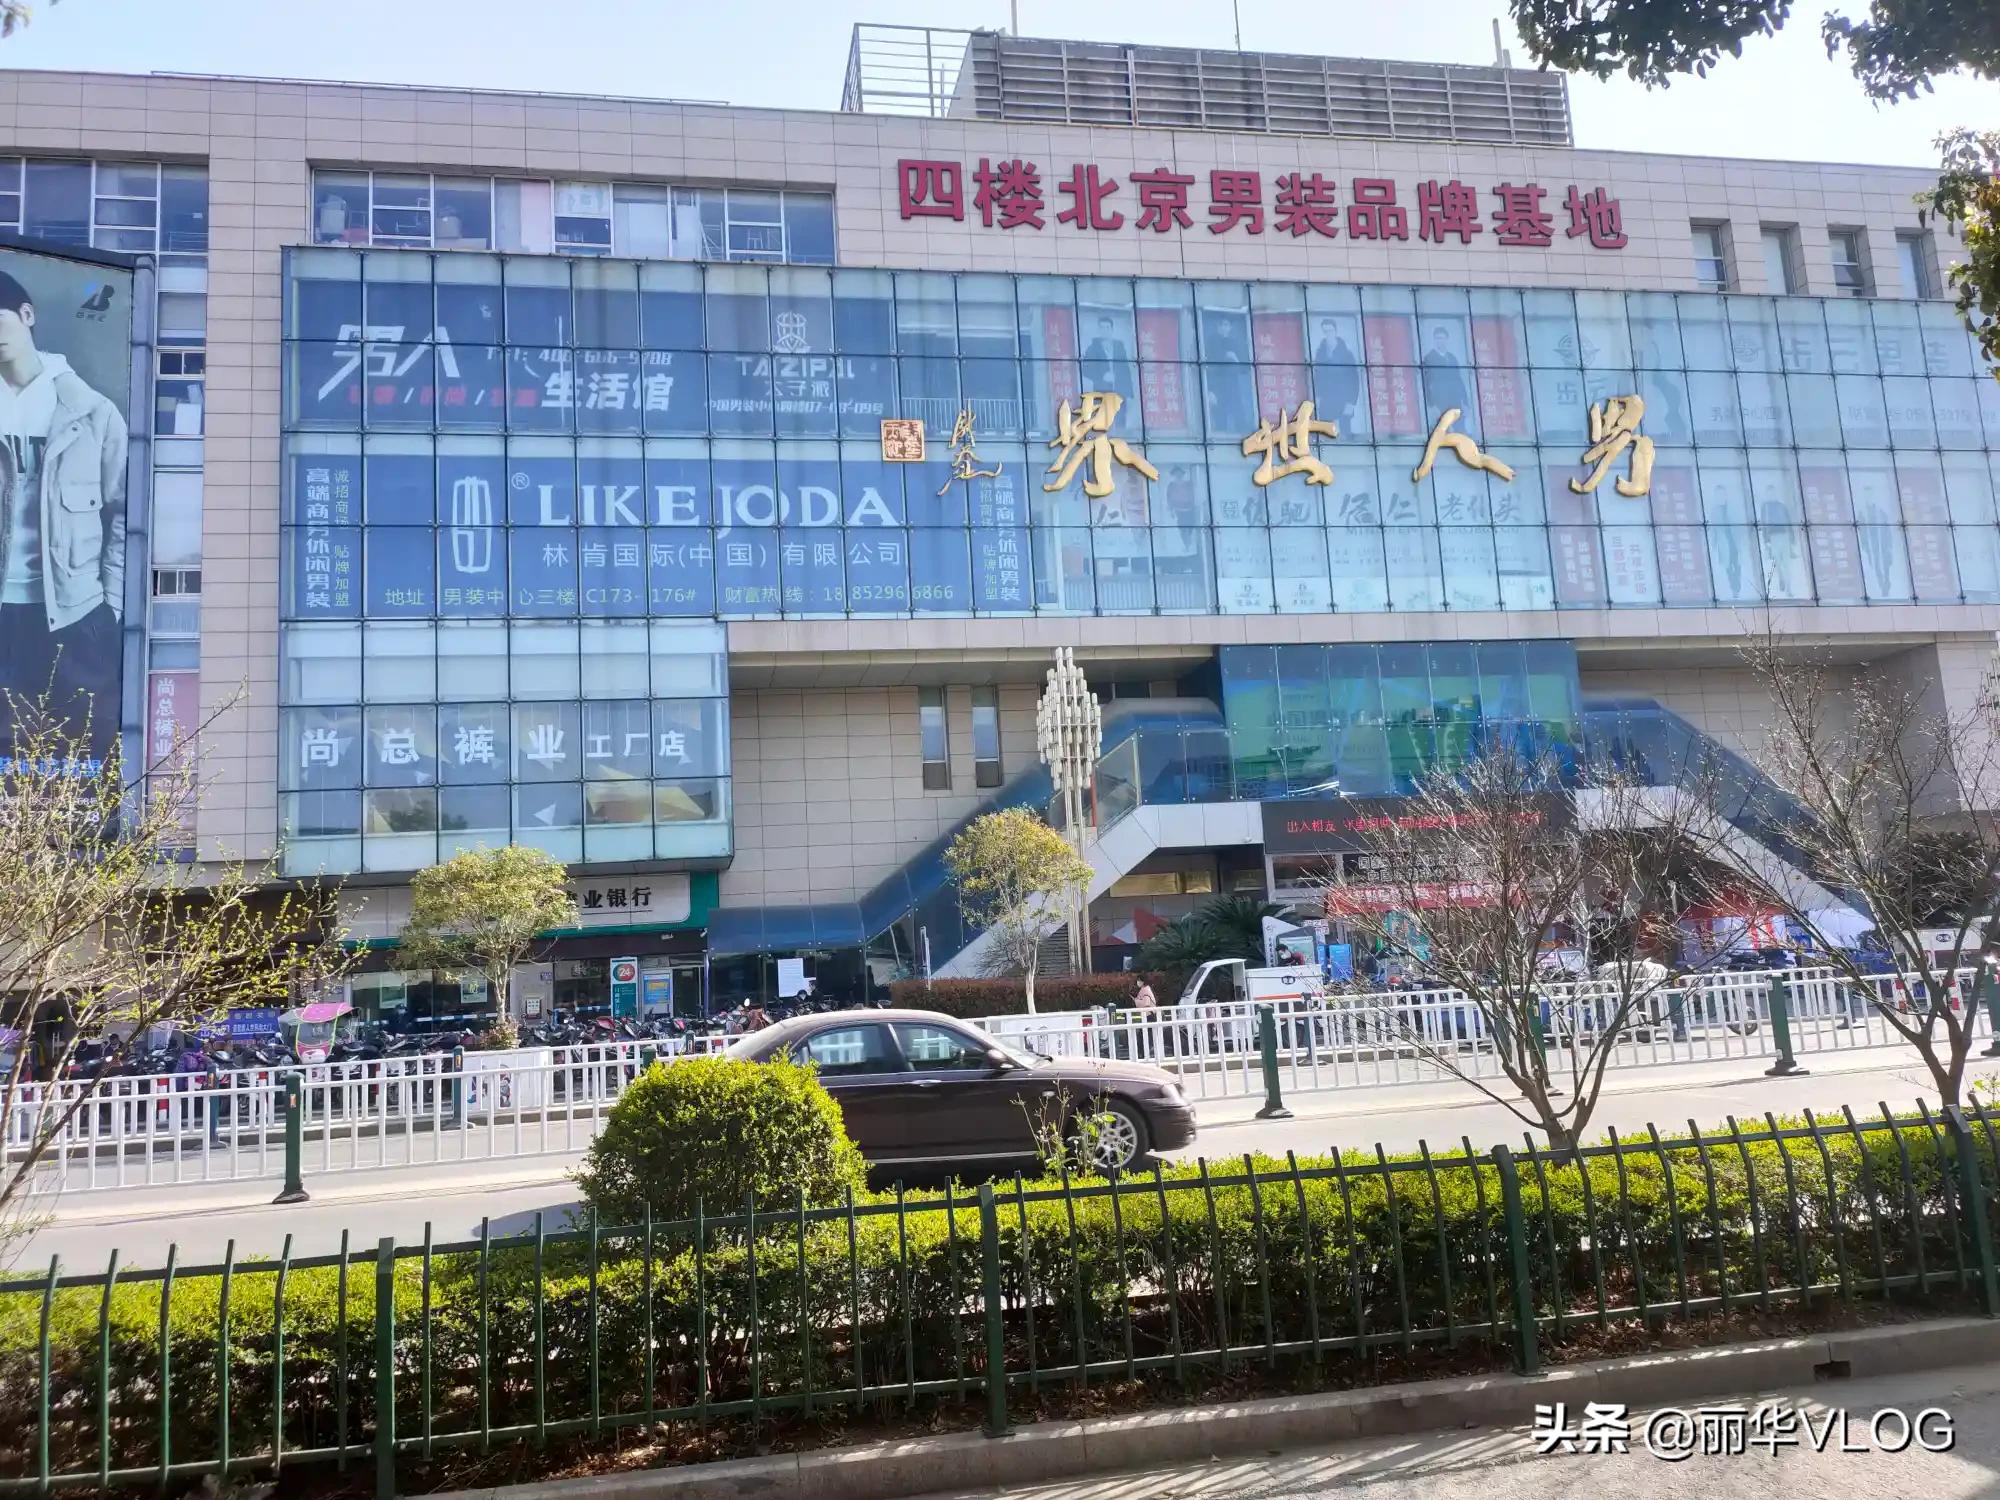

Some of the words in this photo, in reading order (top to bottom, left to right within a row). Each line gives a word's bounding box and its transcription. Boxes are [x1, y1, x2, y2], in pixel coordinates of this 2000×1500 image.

[899, 158, 1628, 251] 四楼北京男装品牌基地
[318, 325, 460, 402] 男人
[541, 372, 674, 412] 生活馆
[305, 467, 331, 609] 高端商务休闲男装
[538, 484, 700, 527] LIKE
[716, 484, 902, 540] JODA
[333, 543, 350, 608] 贴牌加盟
[542, 541, 902, 569] 林肯国际(中国)有限公司
[154, 677, 176, 759] 尚总裤业
